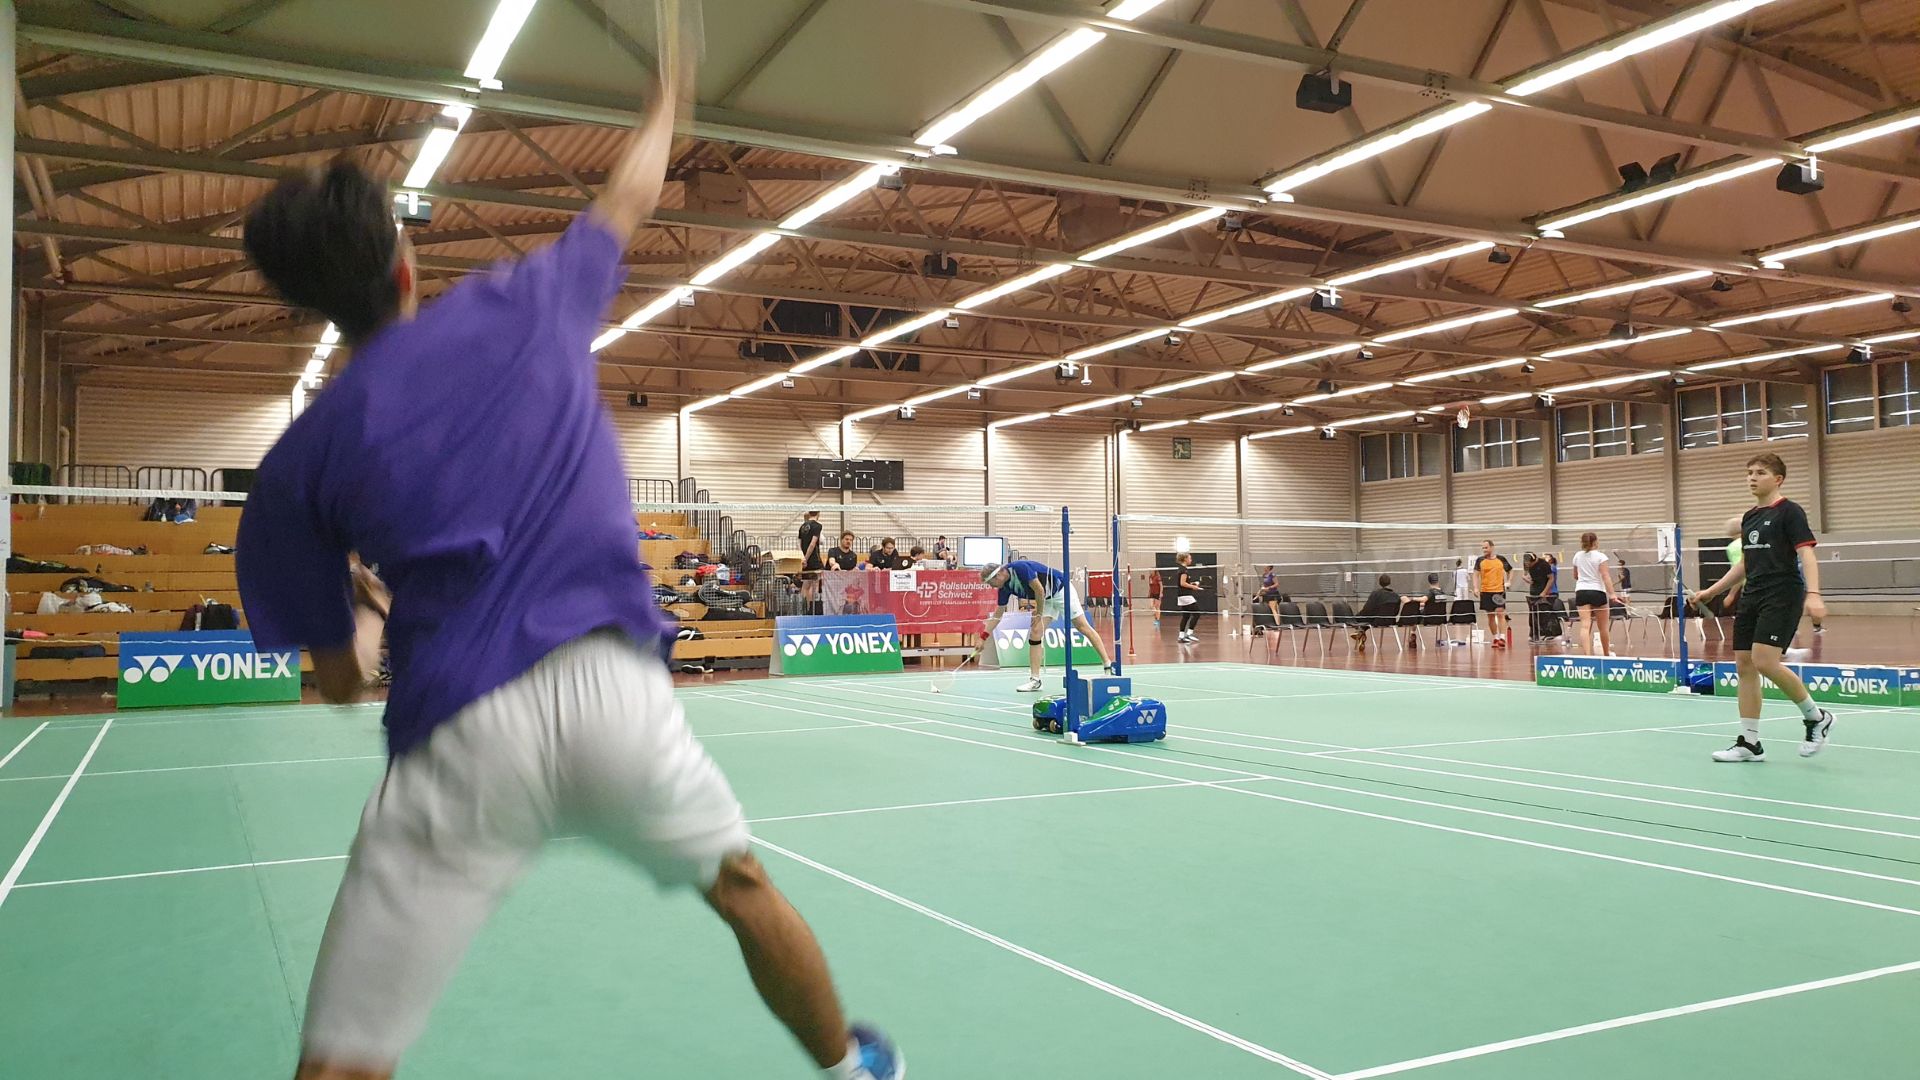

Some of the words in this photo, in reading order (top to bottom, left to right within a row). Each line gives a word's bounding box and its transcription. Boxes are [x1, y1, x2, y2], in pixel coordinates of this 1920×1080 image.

[937, 590, 973, 599] Schweiz
[938, 581, 993, 592] Rollstuhlspo
[825, 632, 896, 655] YONEX
[1044, 627, 1094, 649] ONEX
[190, 652, 292, 681] YONEX
[1561, 666, 1595, 680] YONEX
[1630, 669, 1668, 684] YONEX
[1838, 677, 1889, 695] YONEX
